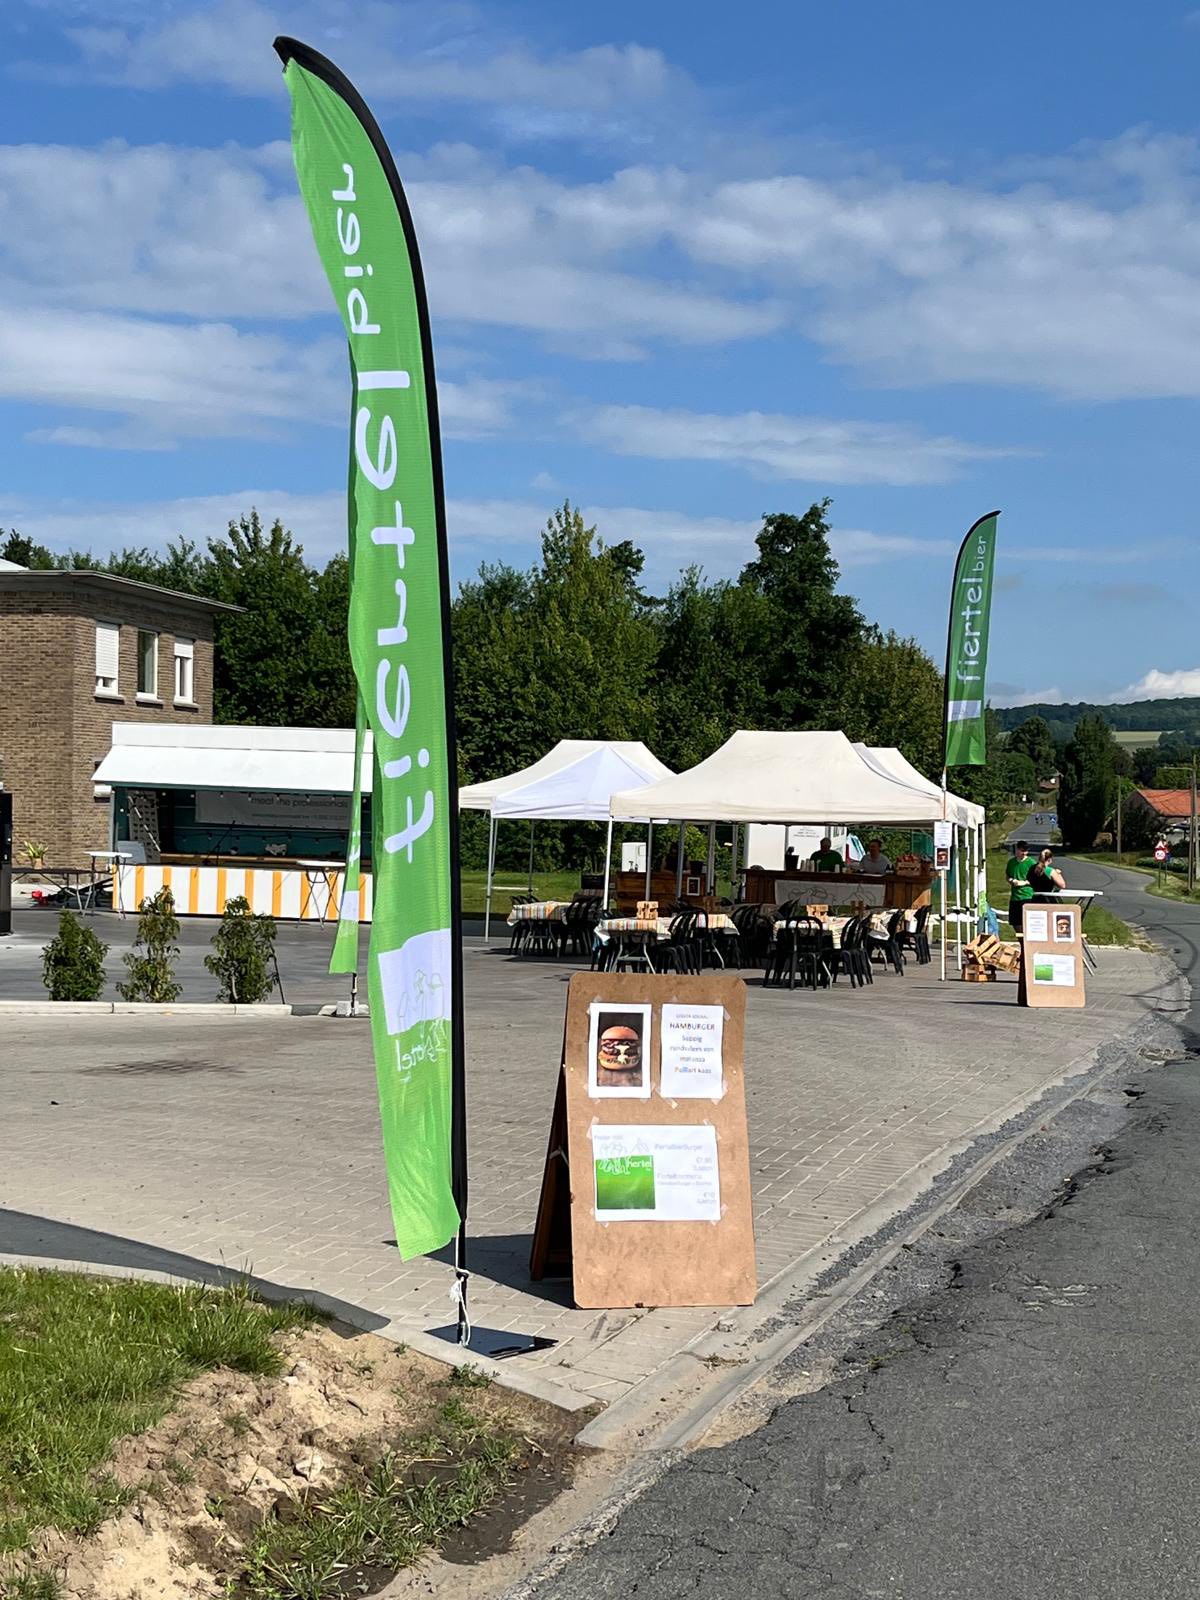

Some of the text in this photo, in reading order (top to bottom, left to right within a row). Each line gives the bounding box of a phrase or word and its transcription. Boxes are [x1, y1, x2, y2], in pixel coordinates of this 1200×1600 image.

[956, 535, 987, 685] fiertel bier
[669, 1022, 715, 1031] HAMBURGER
